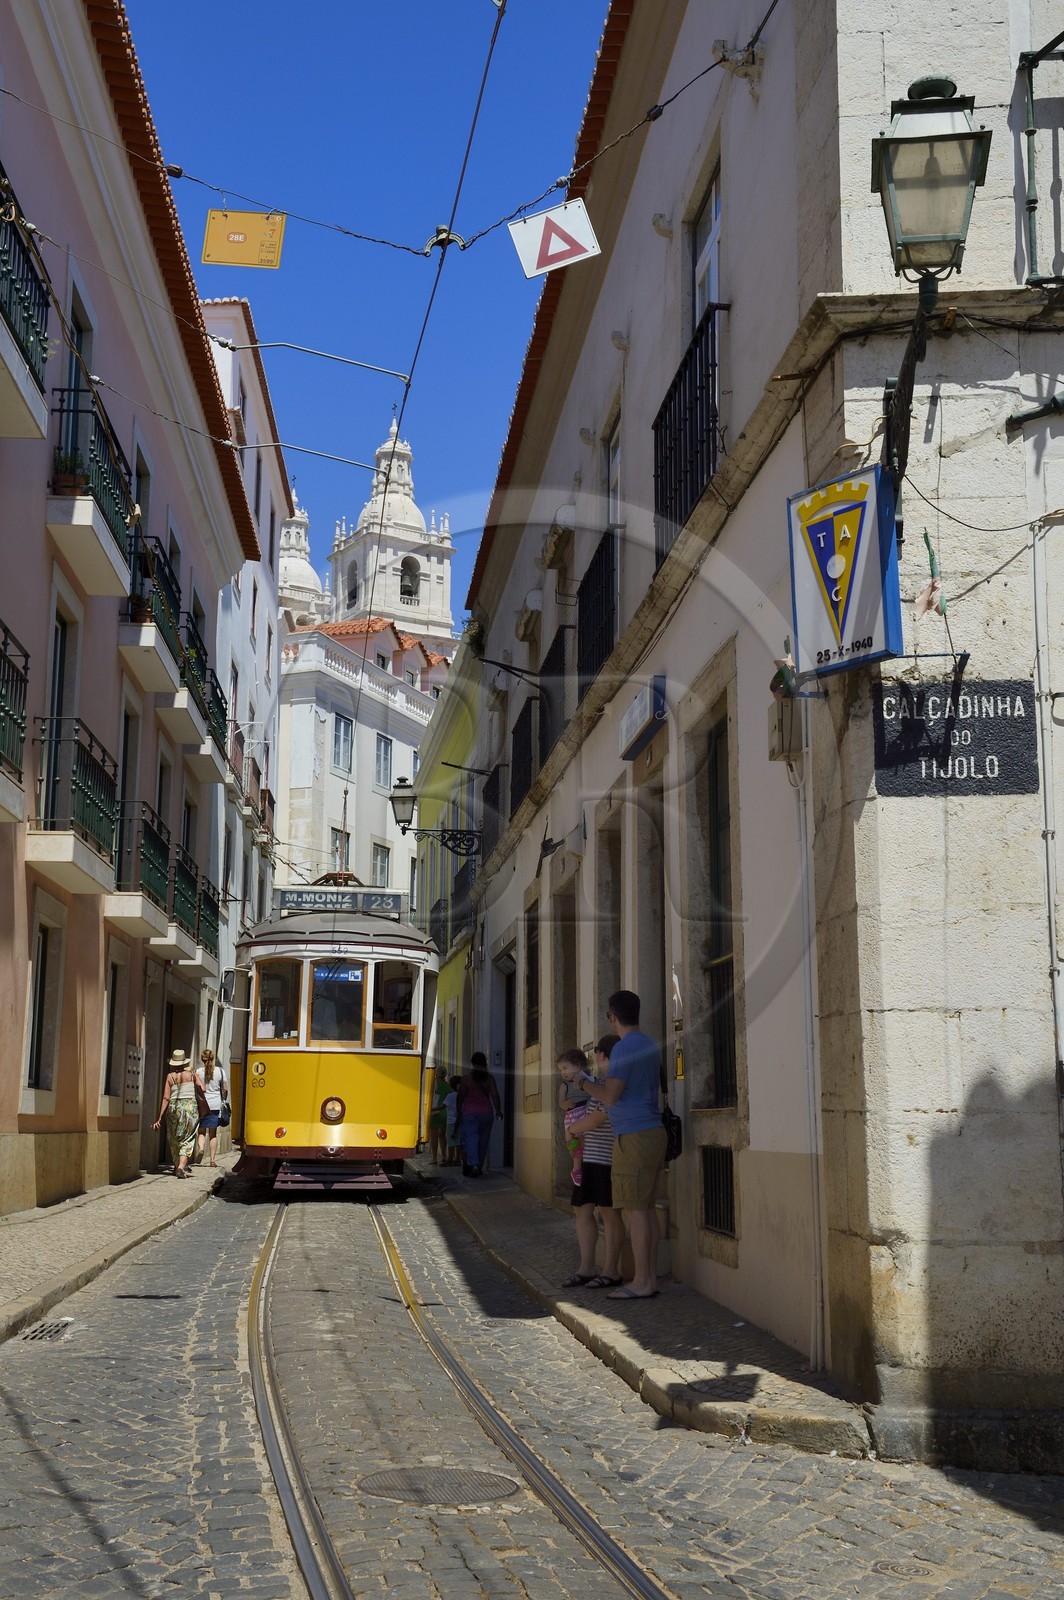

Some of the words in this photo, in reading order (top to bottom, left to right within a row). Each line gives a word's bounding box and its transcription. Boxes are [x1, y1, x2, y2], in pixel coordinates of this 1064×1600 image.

[229, 234, 245, 242] 28E
[817, 532, 827, 548] T
[840, 524, 851, 541] A
[831, 586, 842, 602] C
[817, 636, 873, 664] 25-X-1940
[882, 694, 1026, 726] CALÇADINHA
[951, 729, 972, 746] DO
[918, 755, 1000, 779] TIJOLO
[285, 892, 352, 903] M.MONIZ
[371, 896, 394, 909] 28
